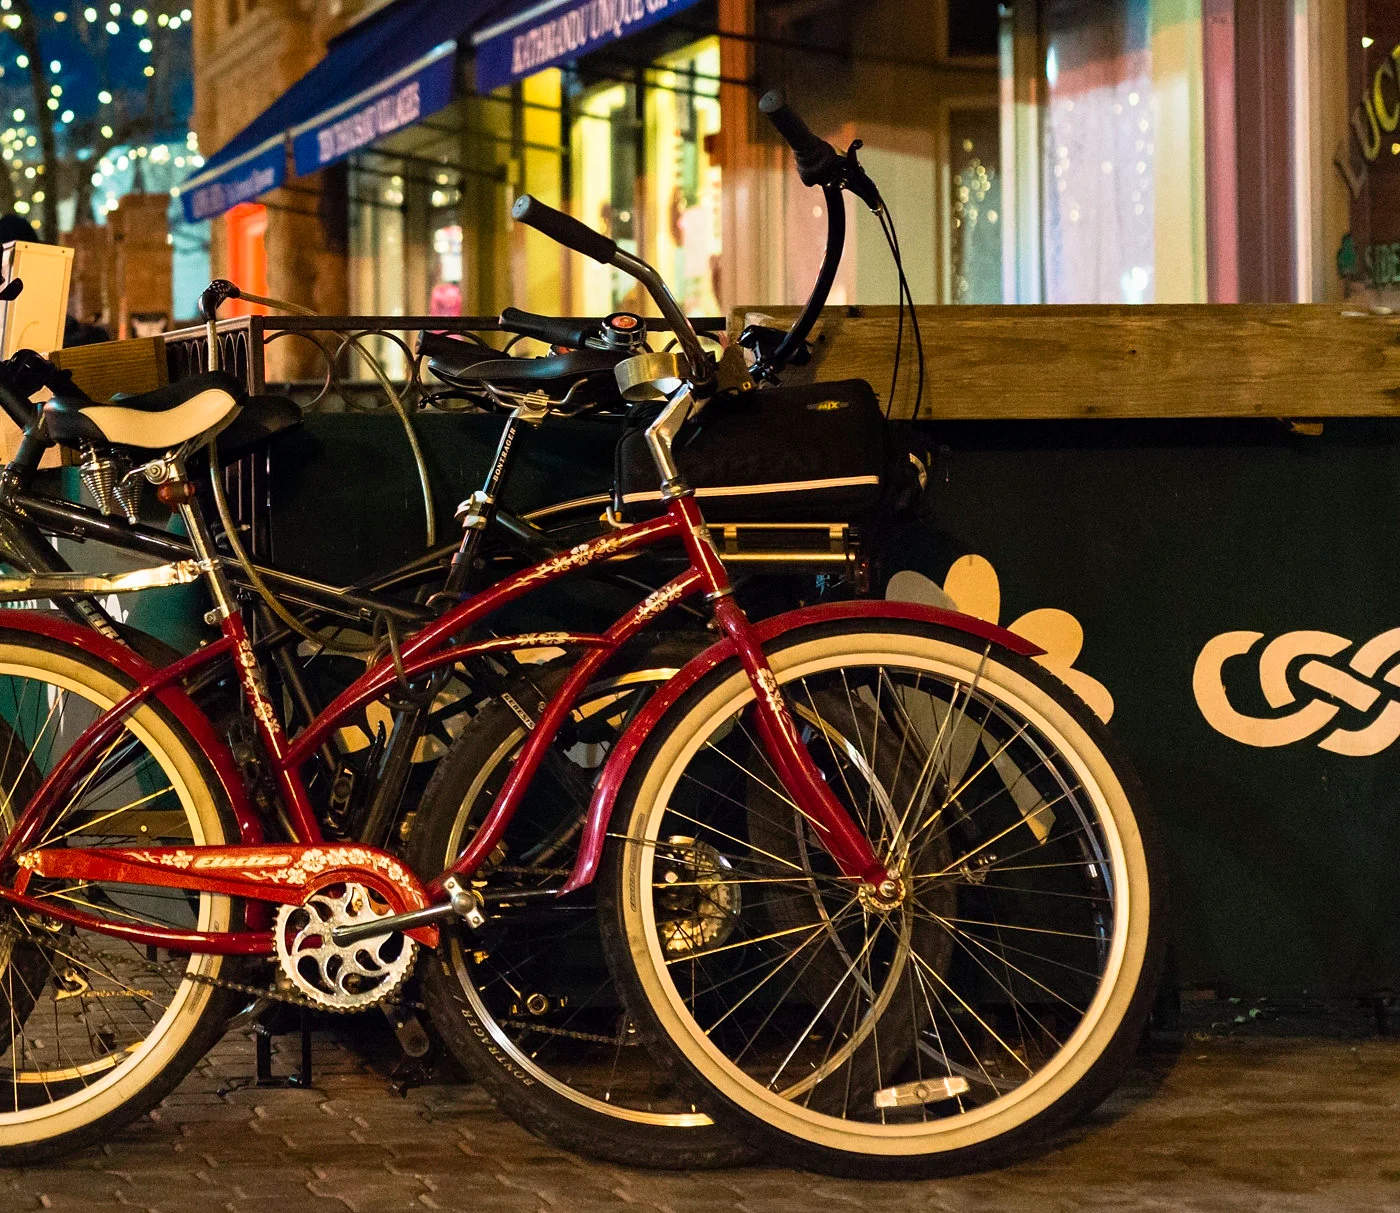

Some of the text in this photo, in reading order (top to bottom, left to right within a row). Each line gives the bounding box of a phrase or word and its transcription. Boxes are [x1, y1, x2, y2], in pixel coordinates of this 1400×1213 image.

[1333, 44, 1400, 199] LUC
[493, 427, 517, 482] BONTRAGER
[461, 1009, 536, 1087] BONTRAGER
